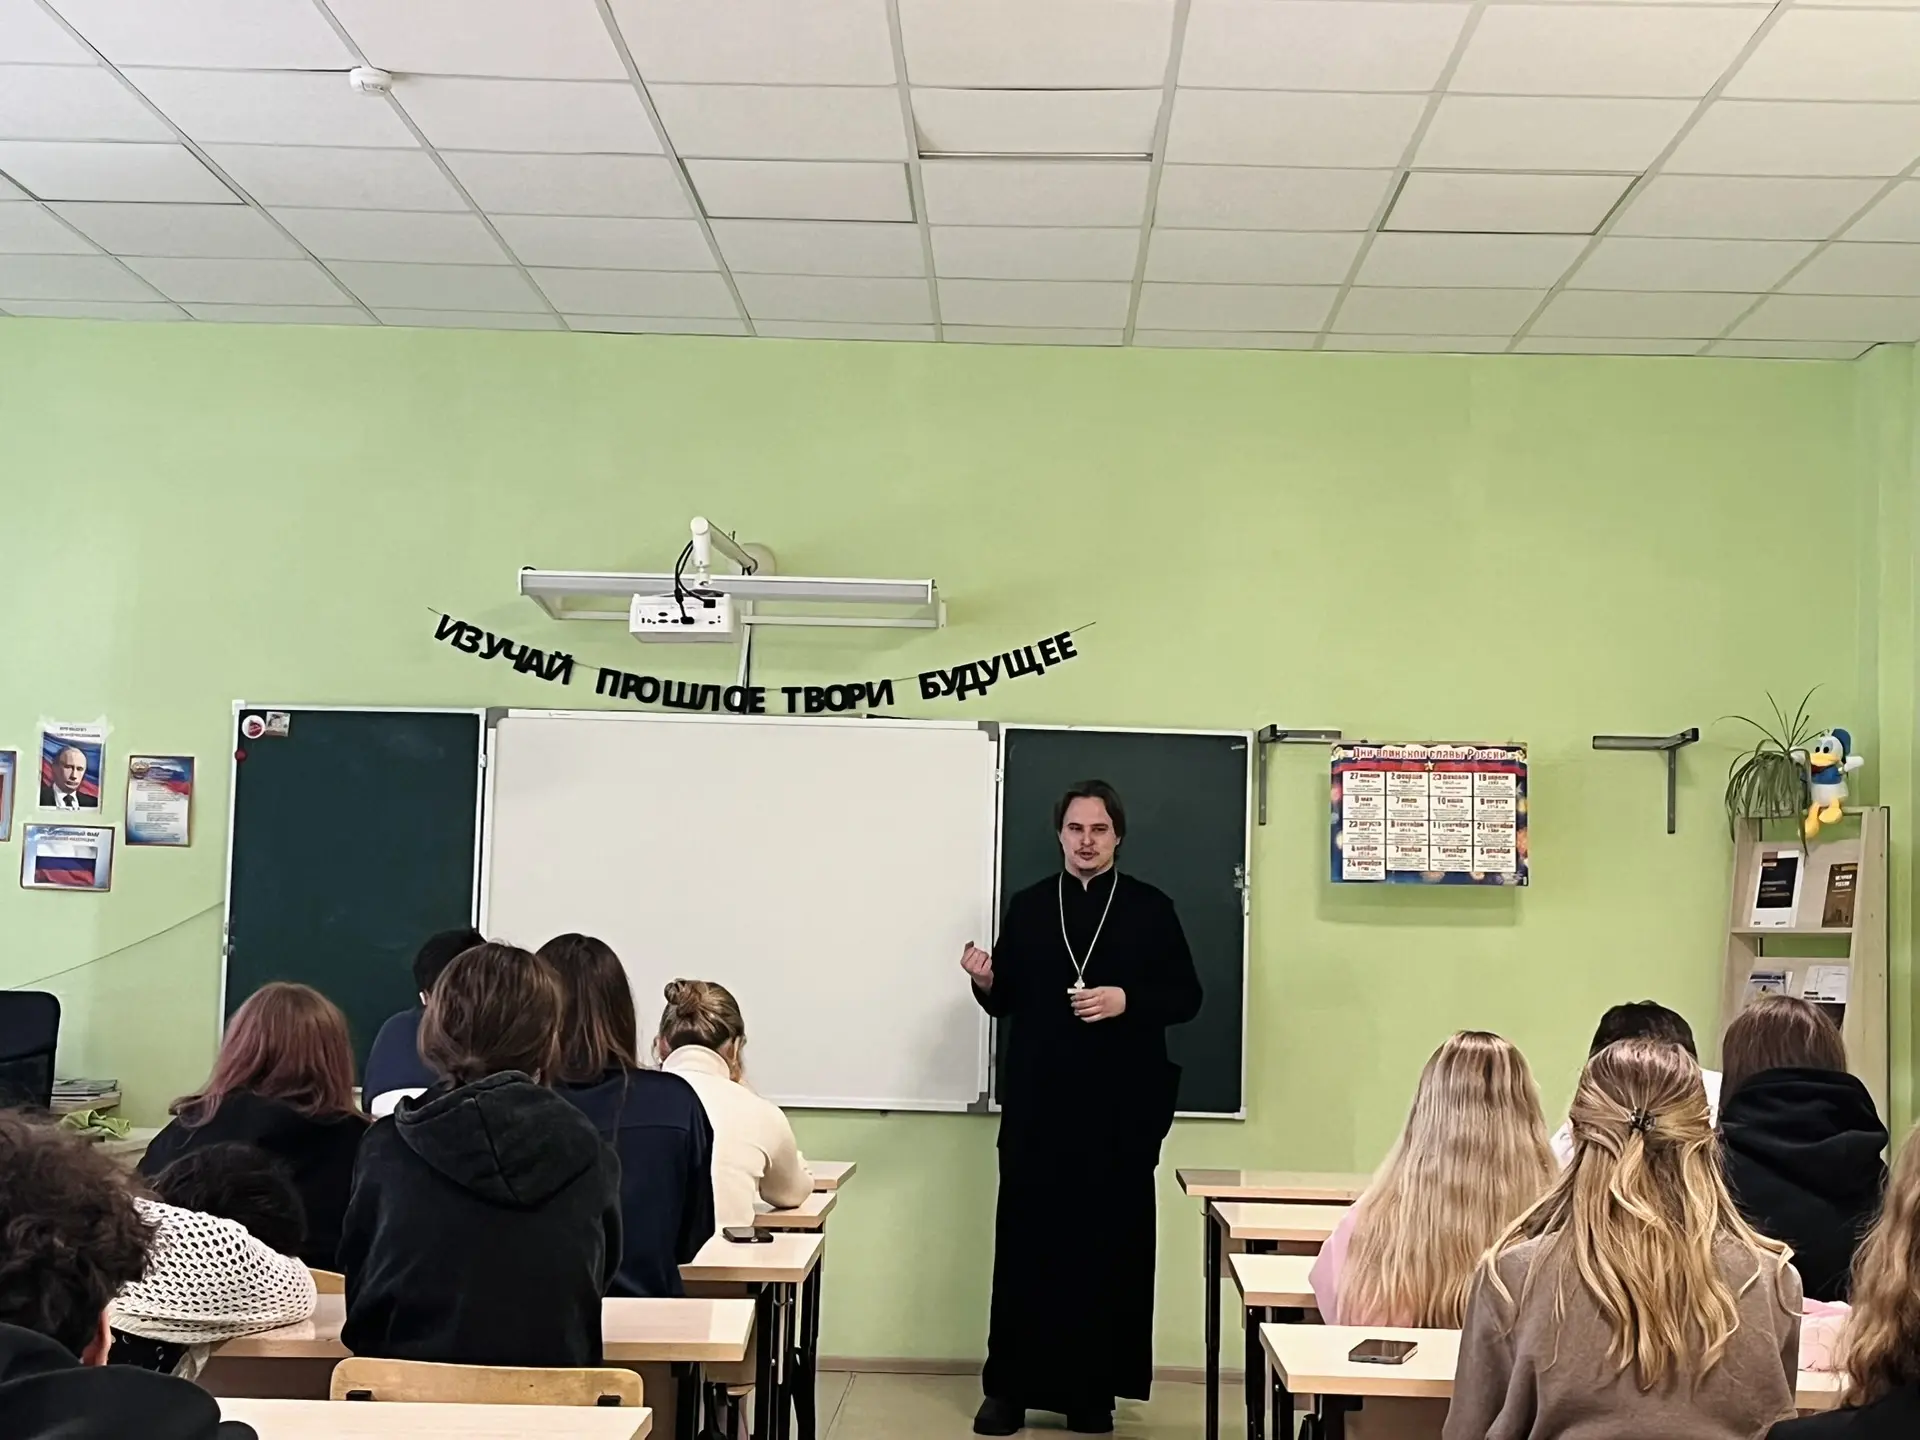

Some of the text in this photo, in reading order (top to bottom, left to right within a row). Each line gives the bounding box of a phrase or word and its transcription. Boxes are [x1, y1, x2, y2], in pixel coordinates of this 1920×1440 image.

[434, 614, 1078, 714] ИЗУЧАЙ ПРОШЛОЕ ТВОРИ БУДУЩЕЕ
[1352, 746, 1374, 760] Дни
[1429, 750, 1466, 760] славы
